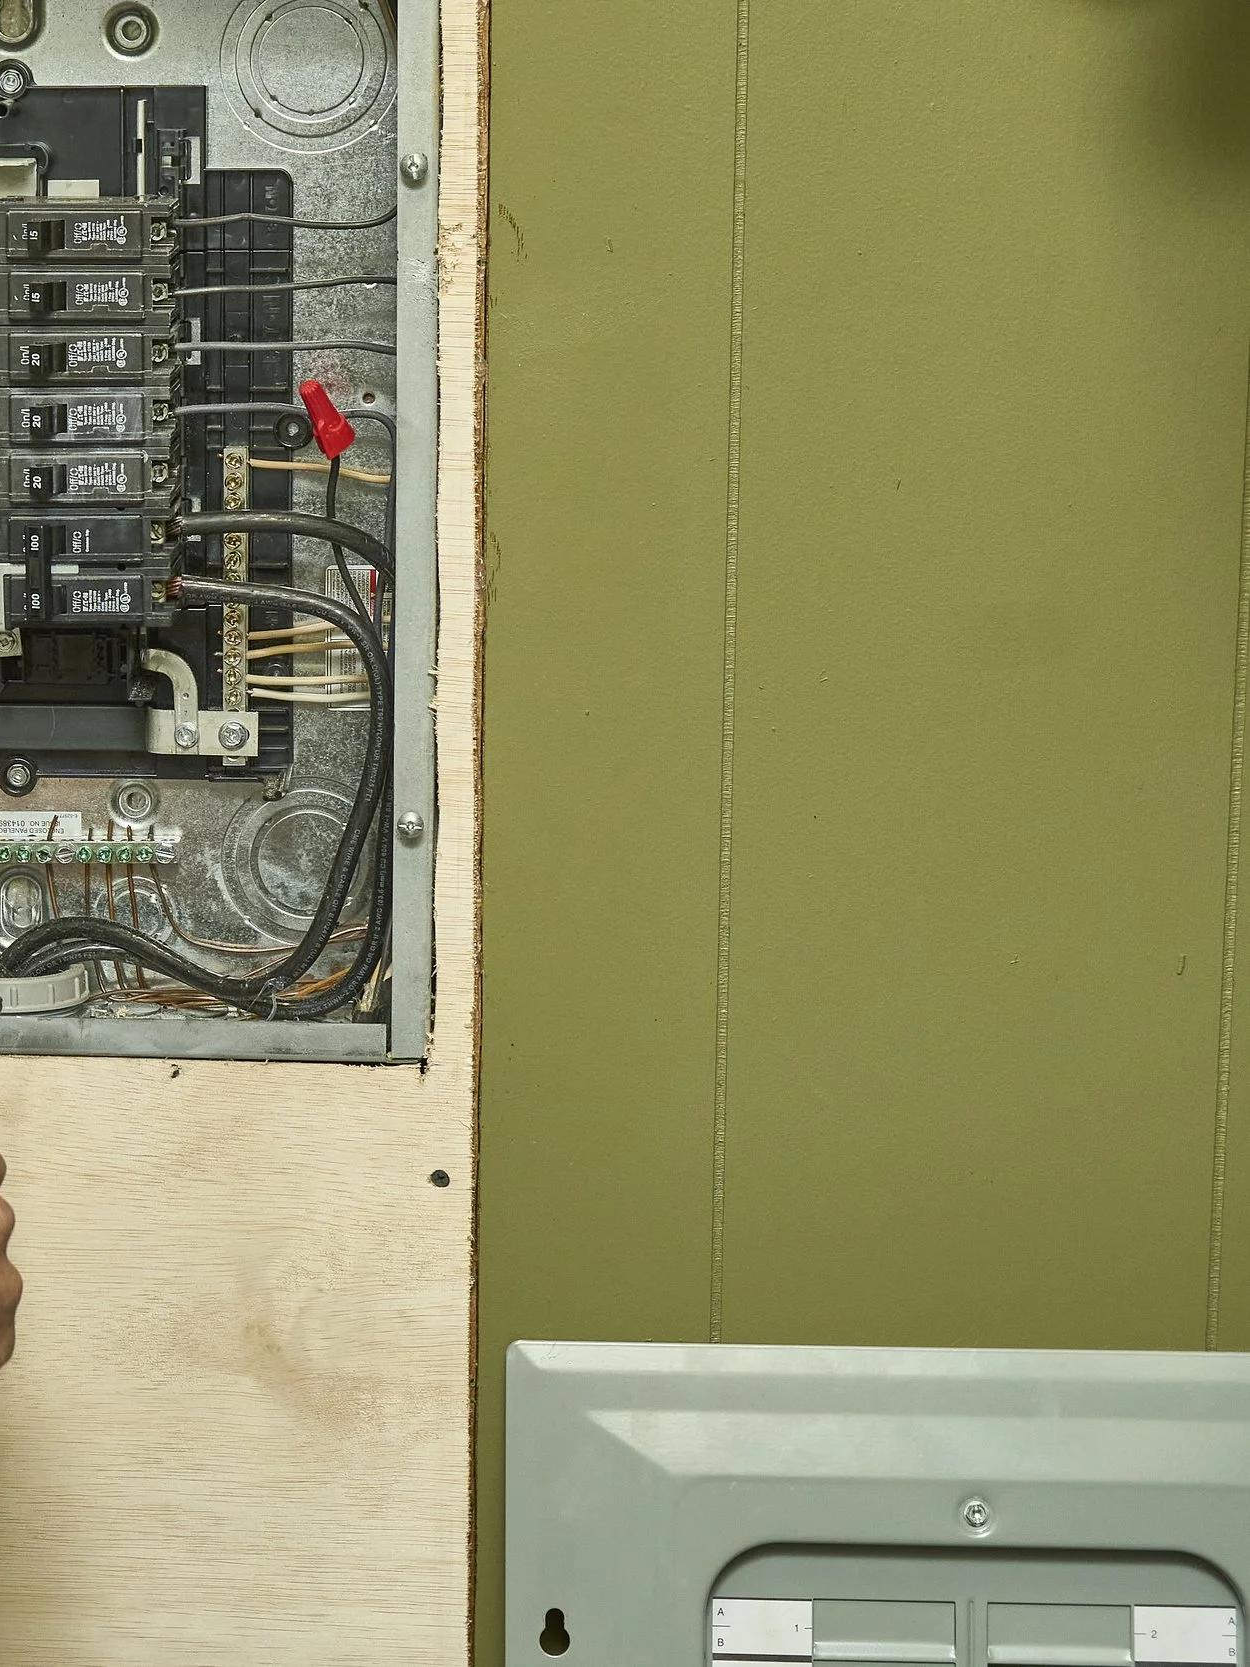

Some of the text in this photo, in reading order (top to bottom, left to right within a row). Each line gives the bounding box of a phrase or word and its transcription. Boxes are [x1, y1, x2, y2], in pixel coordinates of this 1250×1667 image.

[30, 230, 38, 240] 15
[32, 292, 40, 302] 15
[32, 353, 41, 366] 20
[33, 415, 41, 428] 20
[33, 476, 41, 489] 20
[31, 535, 39, 551] 100
[31, 594, 40, 609] 100
[375, 723, 383, 748] NYLON
[373, 750, 379, 760] OR
[343, 847, 354, 866] WIRE
[717, 1607, 724, 1616] A
[1228, 1617, 1235, 1626] A
[795, 1624, 799, 1632] 1
[1151, 1630, 1158, 1639] 2
[717, 1638, 724, 1647] B
[1228, 1648, 1235, 1657] B
